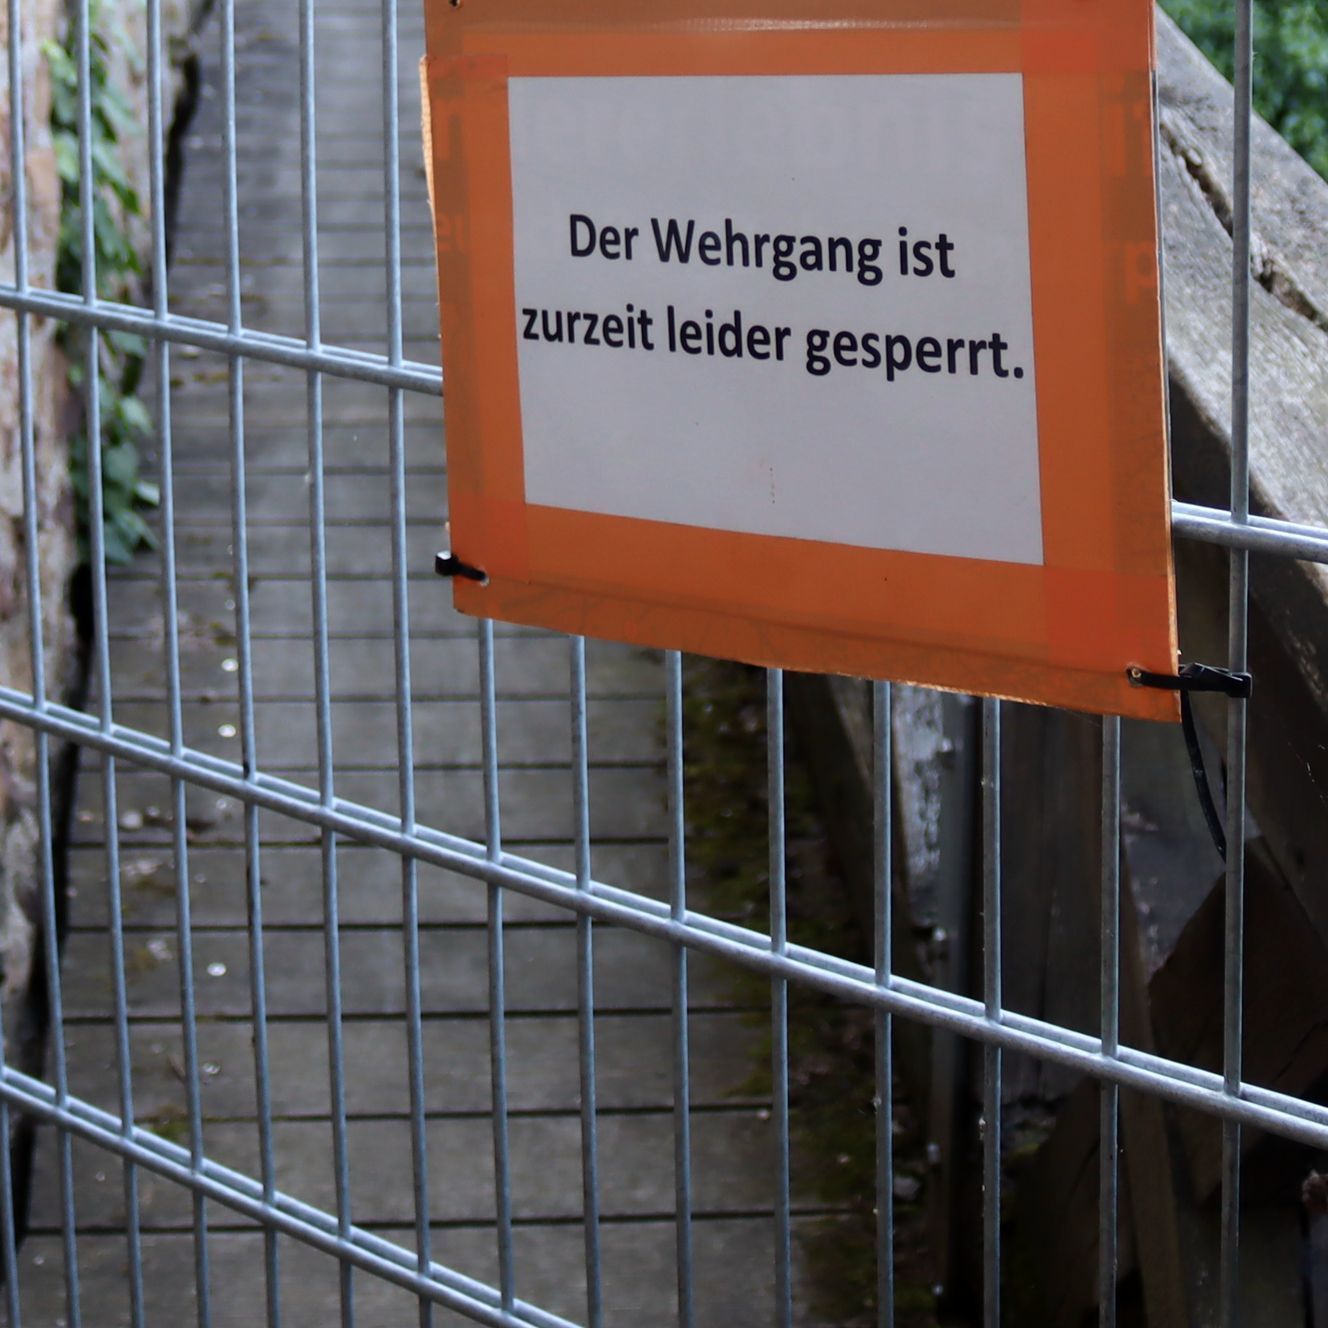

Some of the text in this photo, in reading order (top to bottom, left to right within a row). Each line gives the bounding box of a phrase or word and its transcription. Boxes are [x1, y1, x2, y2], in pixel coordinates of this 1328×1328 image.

[569, 213, 956, 287] Der Wehrgang ist
[521, 302, 1024, 383] zurzeit leider gesperrt.
